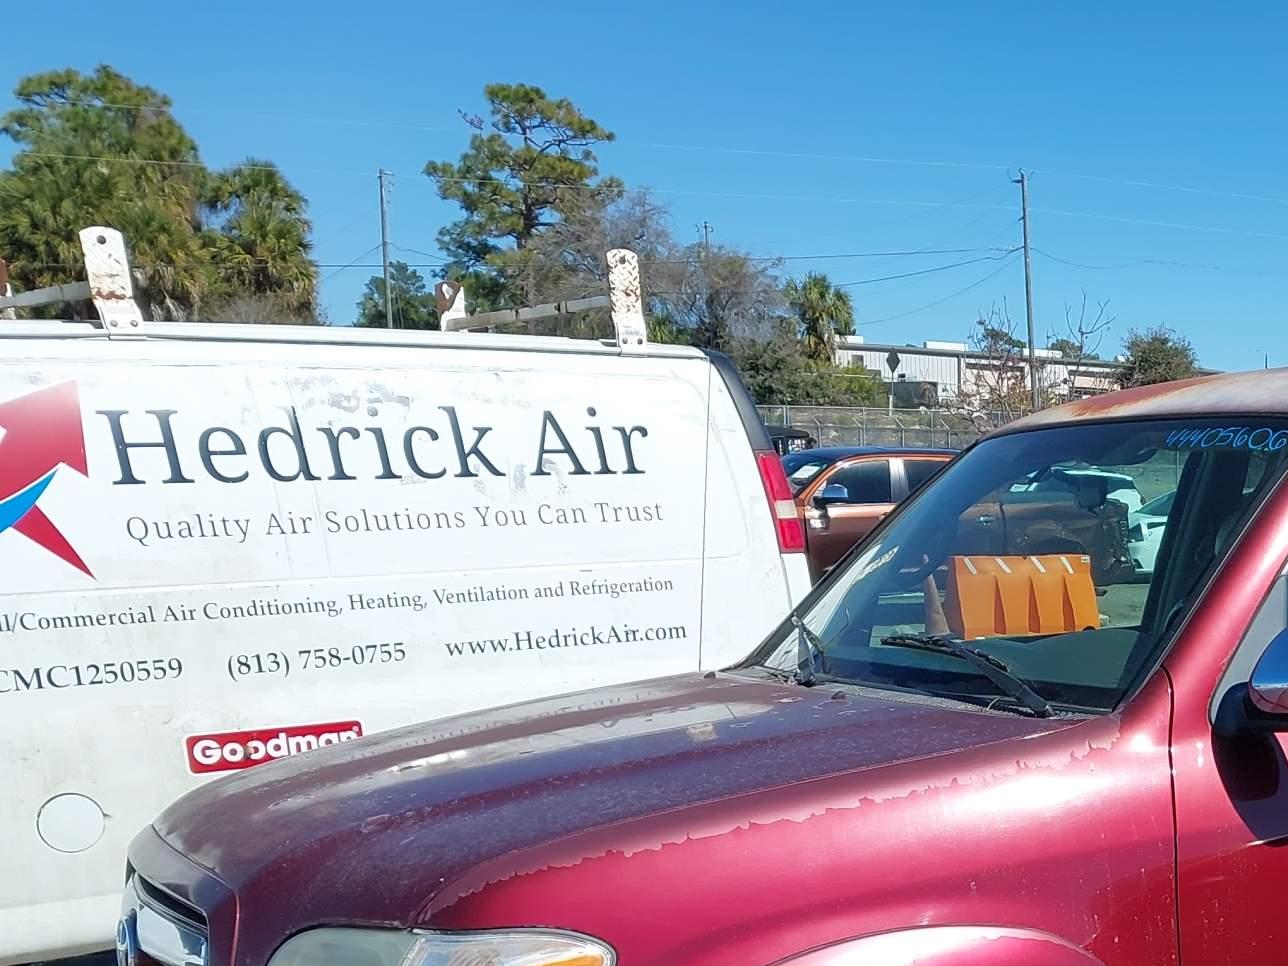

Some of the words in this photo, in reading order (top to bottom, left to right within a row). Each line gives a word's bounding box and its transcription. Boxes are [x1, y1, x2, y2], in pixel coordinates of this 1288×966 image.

[96, 405, 506, 485] Hedrick
[530, 406, 649, 475] Air
[1166, 427, 1288, 450] 44405606
[126, 513, 250, 546] Quality
[266, 512, 312, 535] Air
[325, 508, 466, 533] Solutions
[473, 506, 527, 527] You
[538, 503, 587, 524] Can
[594, 502, 664, 523] Trust
[163, 603, 196, 621] Air
[203, 596, 343, 619] Conditioning,
[347, 591, 428, 612] Heating,
[432, 585, 529, 605] Ventilation
[534, 582, 565, 599] and
[569, 577, 674, 599] Refrigeration
[444, 622, 688, 657] www.HedrickAir.com
[228, 650, 290, 682] (813)
[298, 641, 407, 671] 758-0755
